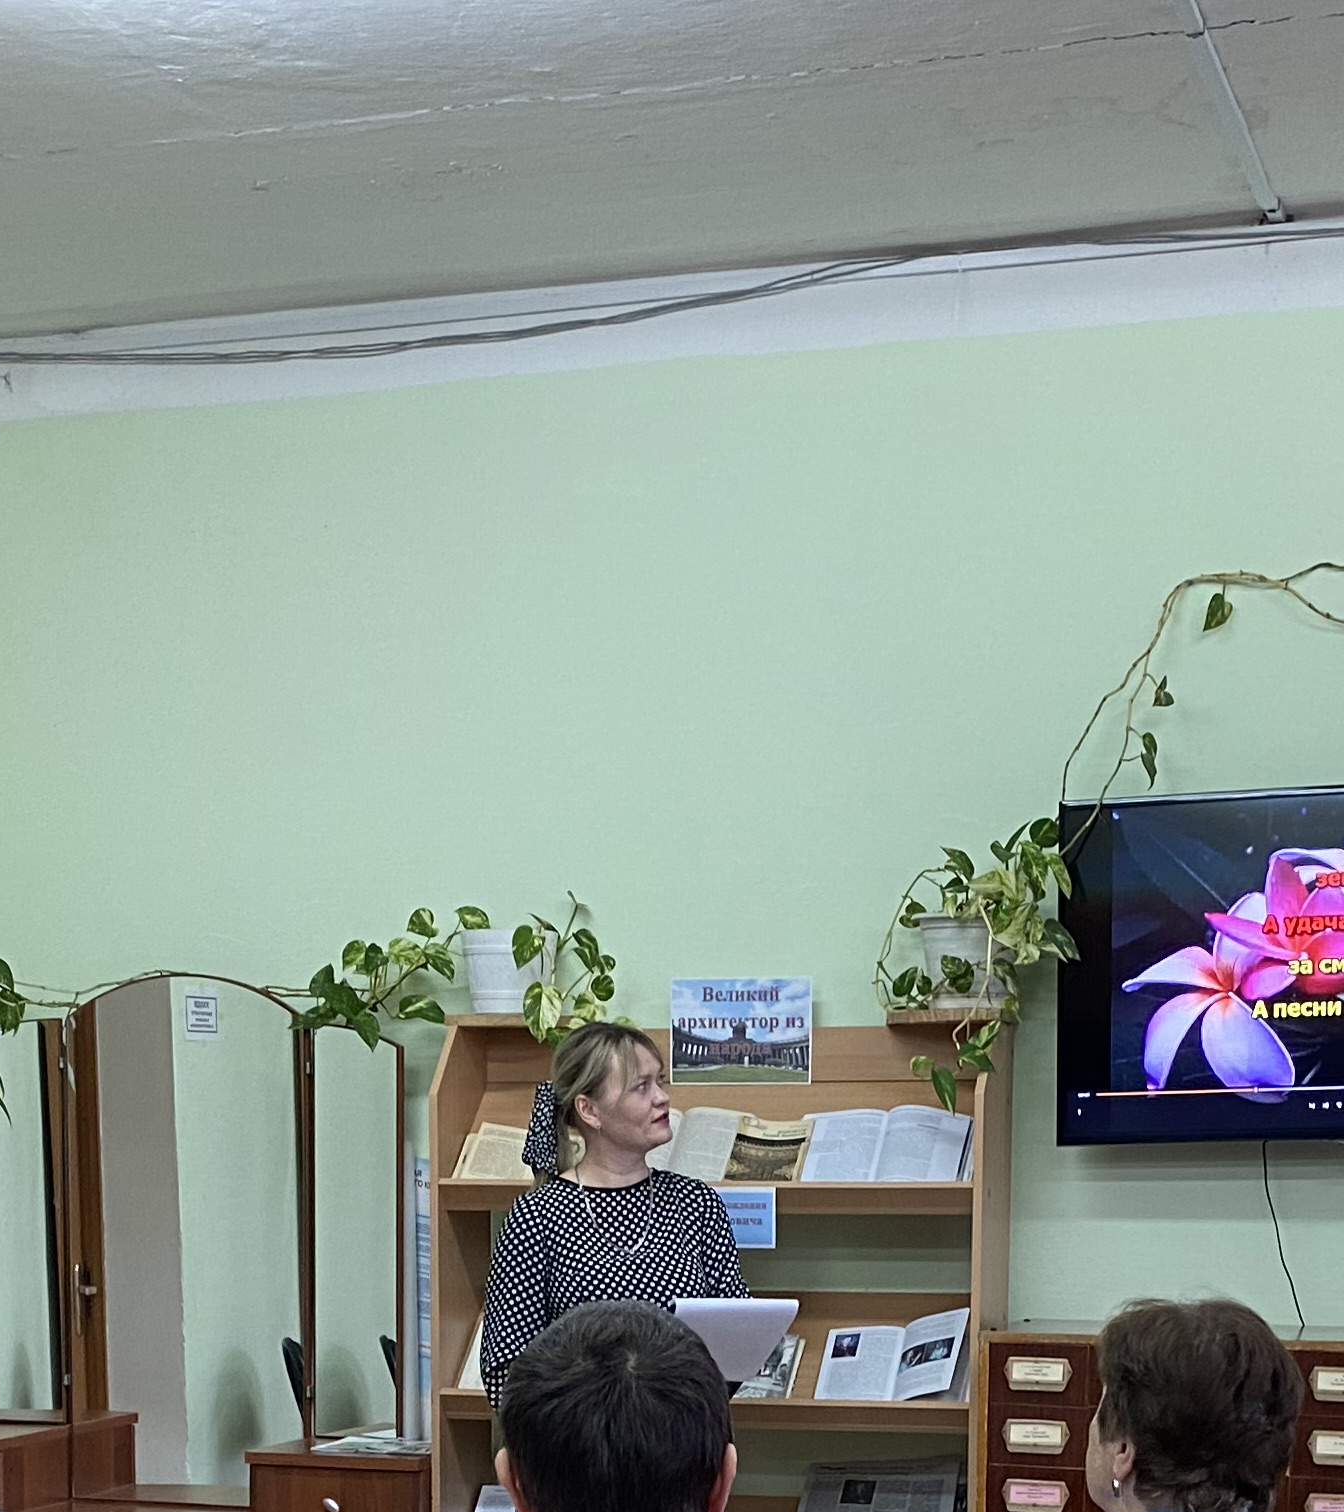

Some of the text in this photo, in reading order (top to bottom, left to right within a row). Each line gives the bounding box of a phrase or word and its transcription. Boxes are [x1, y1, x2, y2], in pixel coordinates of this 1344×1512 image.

[1263, 915, 1279, 934] А
[1288, 959, 1313, 975] за
[702, 986, 780, 1002] Великий
[1252, 1000, 1269, 1019] А
[1273, 1000, 1342, 1018] песни
[786, 1016, 805, 1029] из
[708, 1043, 773, 1060] народа
